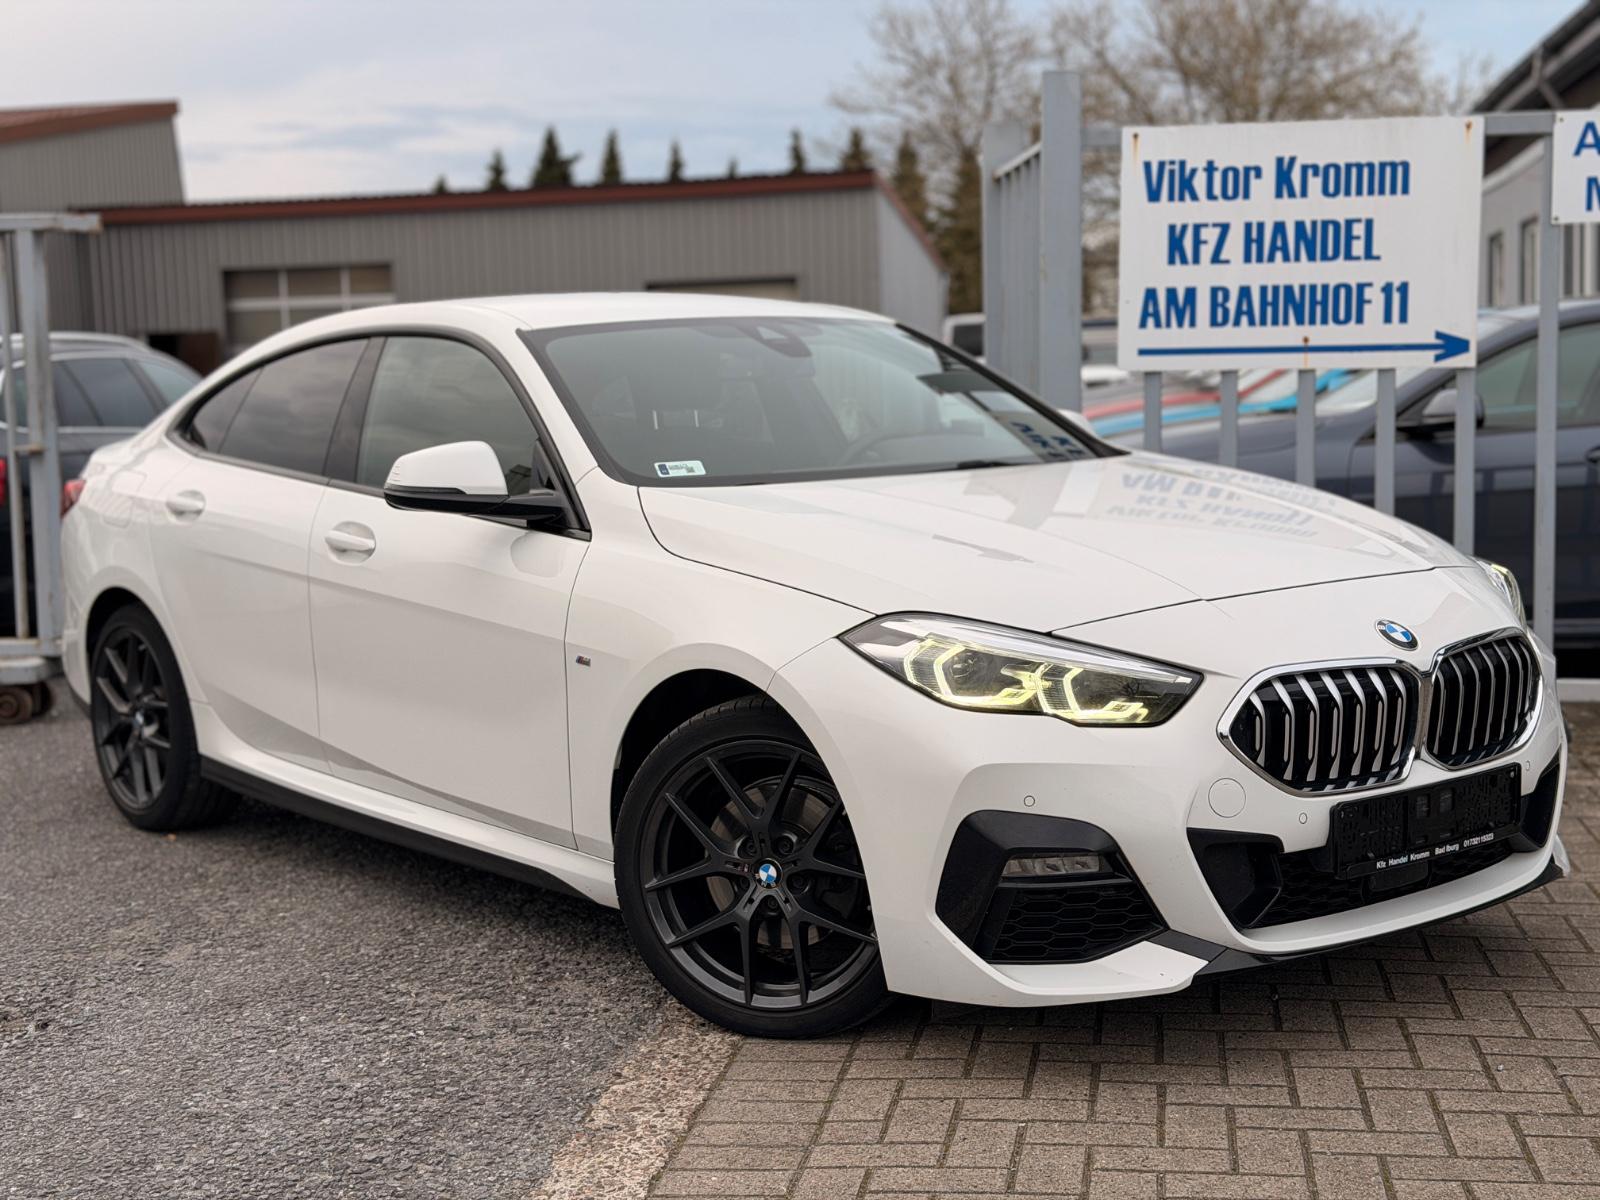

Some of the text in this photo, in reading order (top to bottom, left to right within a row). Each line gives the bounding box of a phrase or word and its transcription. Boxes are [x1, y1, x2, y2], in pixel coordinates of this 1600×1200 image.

[1143, 155, 1411, 203] Viktor Kromm
[1167, 217, 1382, 265] KFZ HANDEL
[1138, 281, 1409, 329] AM BAHNHOF 11
[1388, 855, 1408, 866] Handel
